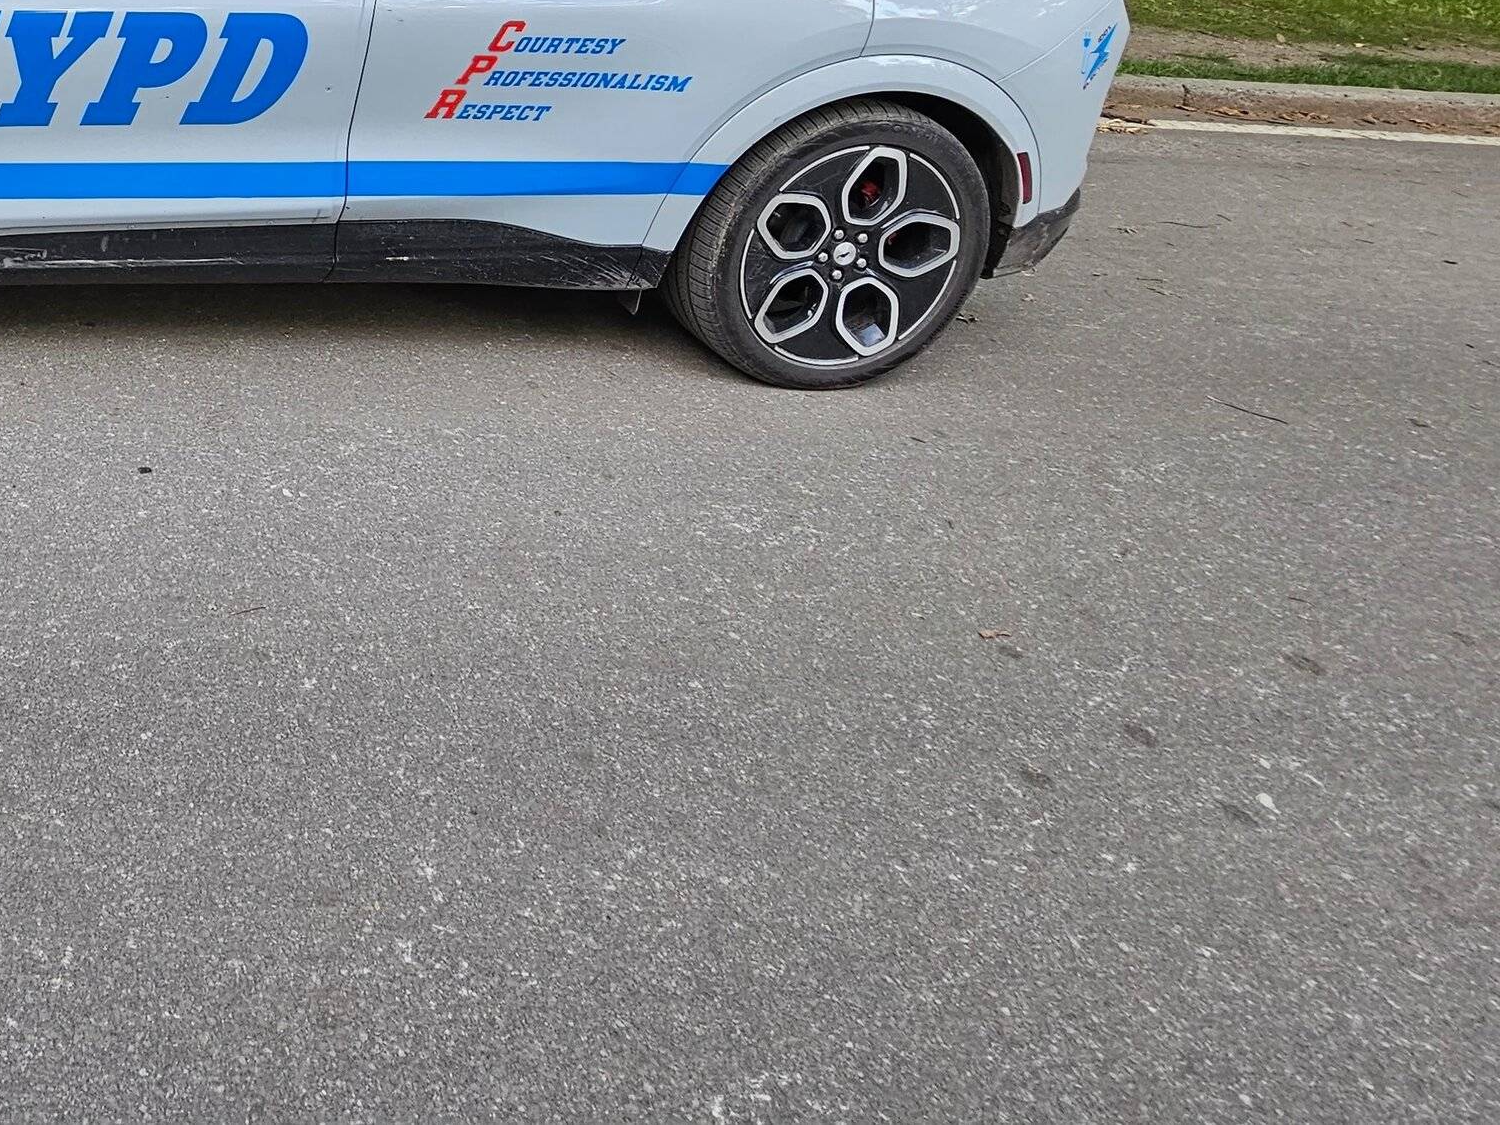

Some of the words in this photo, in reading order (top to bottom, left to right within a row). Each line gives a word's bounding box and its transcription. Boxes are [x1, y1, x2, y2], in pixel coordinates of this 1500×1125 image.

[487, 20, 626, 55] COURTESY
[454, 55, 692, 92] PROFESSIONALISM
[424, 89, 552, 121] RESPECT
